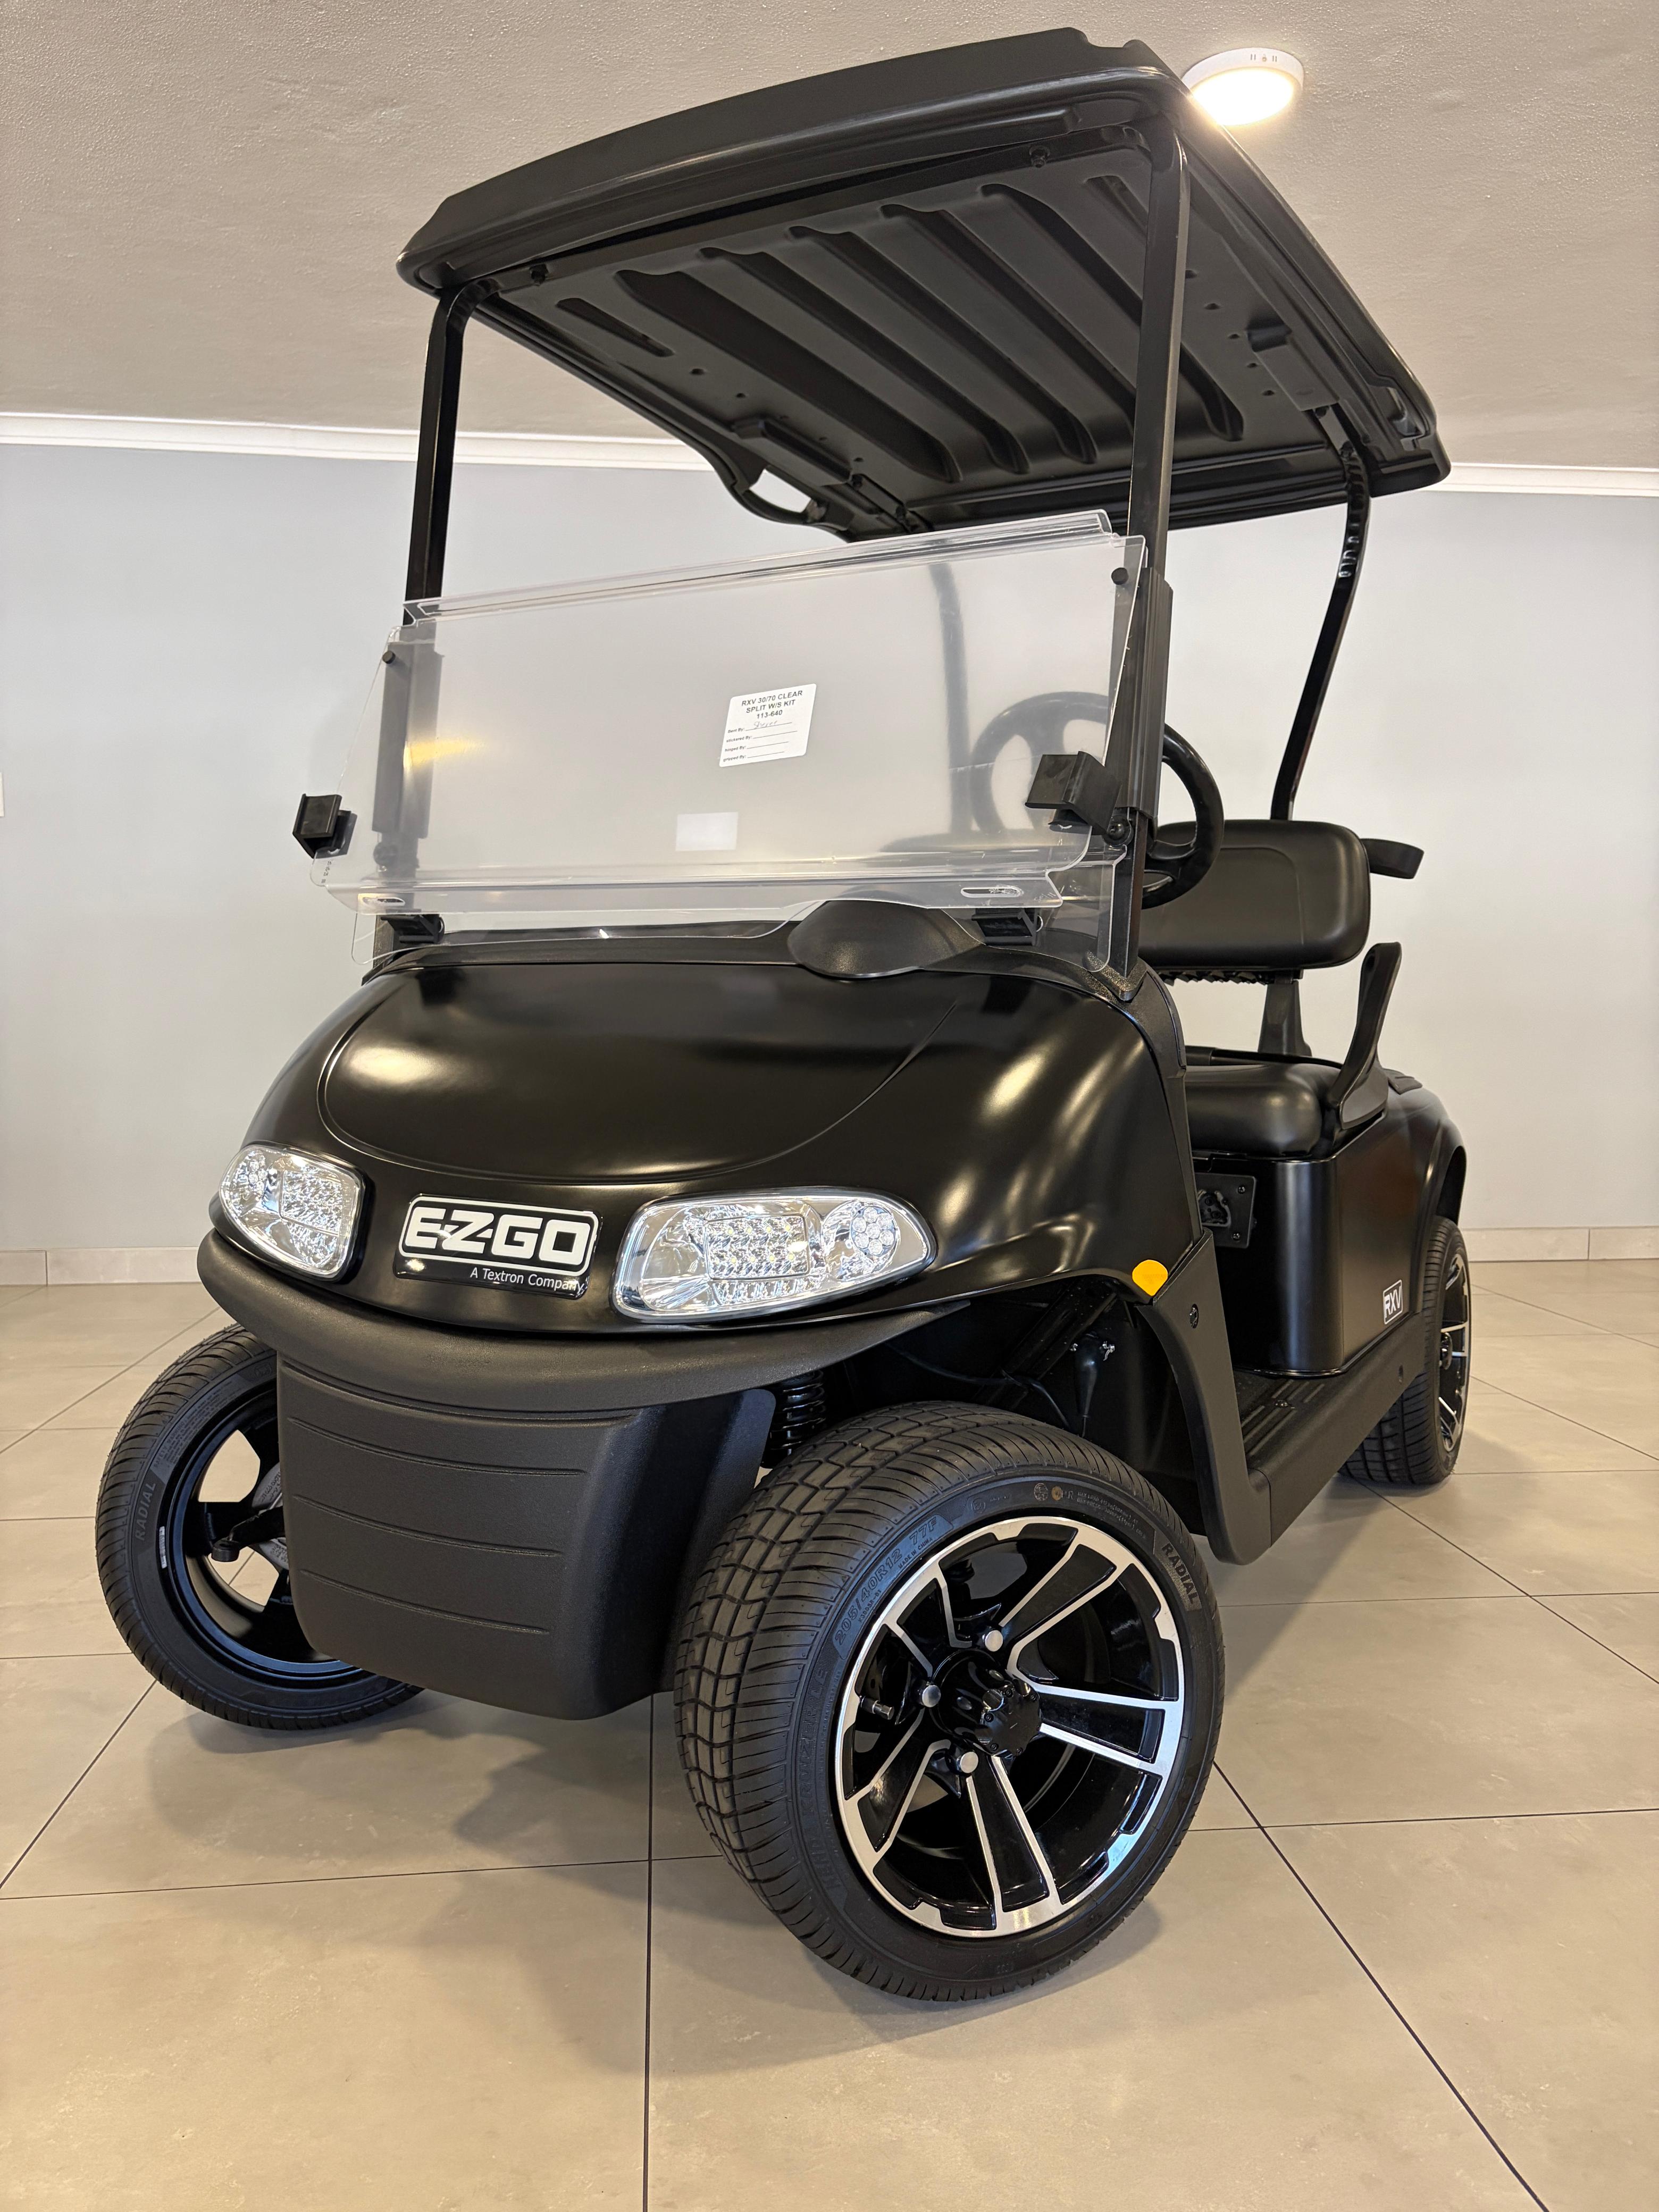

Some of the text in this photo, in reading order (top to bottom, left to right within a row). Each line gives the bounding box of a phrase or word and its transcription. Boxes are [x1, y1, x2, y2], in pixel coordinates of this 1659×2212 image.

[746, 705, 766, 713] SPLIT
[778, 690, 803, 700] CLEAR
[757, 709, 783, 719] 113-640
[470, 1267, 584, 1293] A Textron Company
[1384, 1286, 1402, 1318] RXV
[135, 1483, 156, 1541] RADIAL
[898, 1557, 912, 1569] MADE
[918, 1537, 933, 1551] CHINA
[835, 1517, 936, 1645] 205/40R12 77F
[1162, 1543, 1199, 1604] RADIAL
